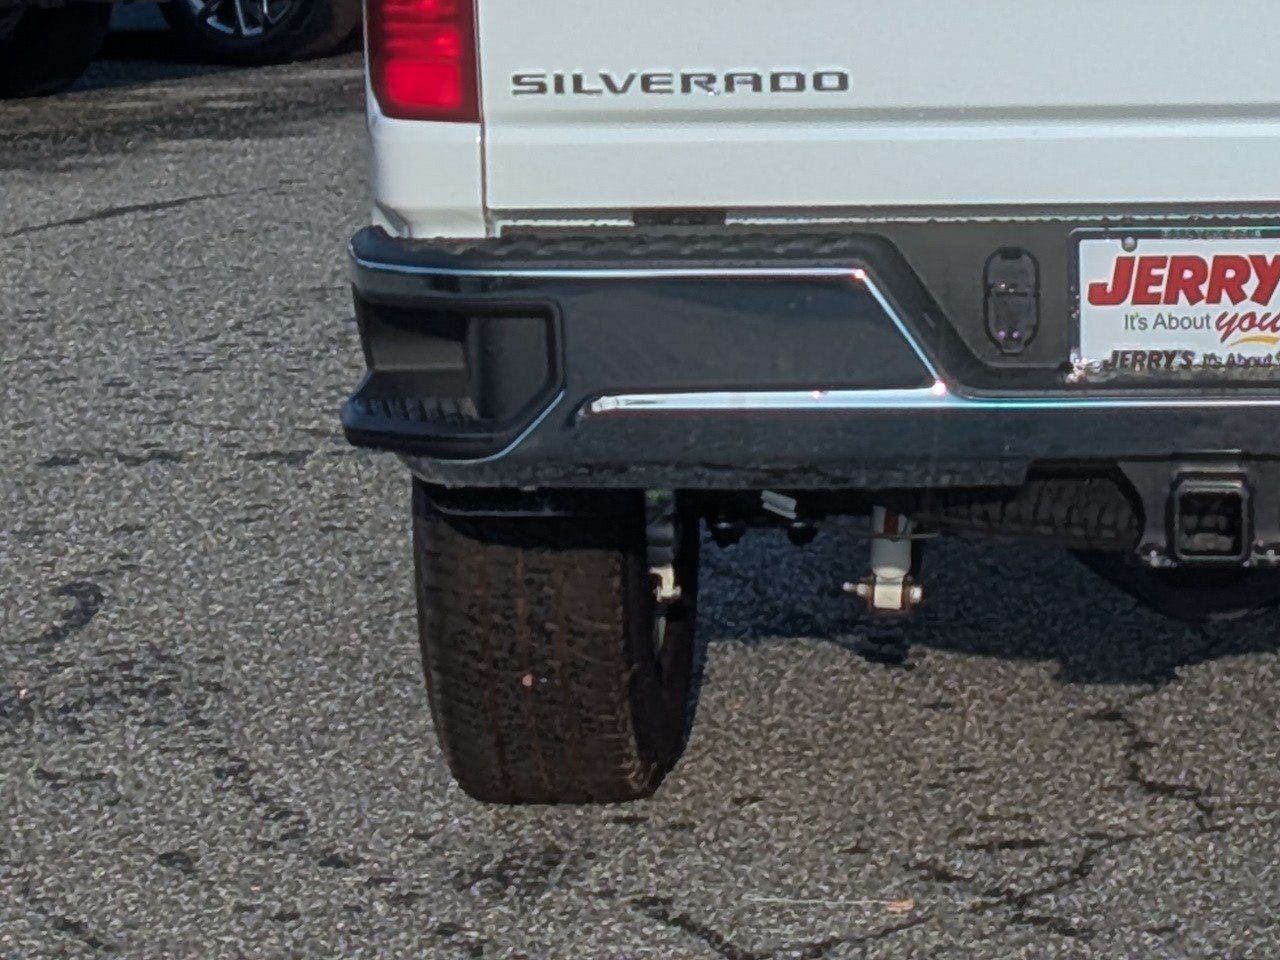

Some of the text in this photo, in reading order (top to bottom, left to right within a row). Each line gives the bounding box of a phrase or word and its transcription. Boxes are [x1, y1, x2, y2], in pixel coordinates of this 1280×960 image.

[511, 71, 849, 95] SILVERADO
[1124, 313, 1149, 331] It's
[1153, 313, 1212, 331] About
[1102, 349, 1196, 371] JERRY'S
